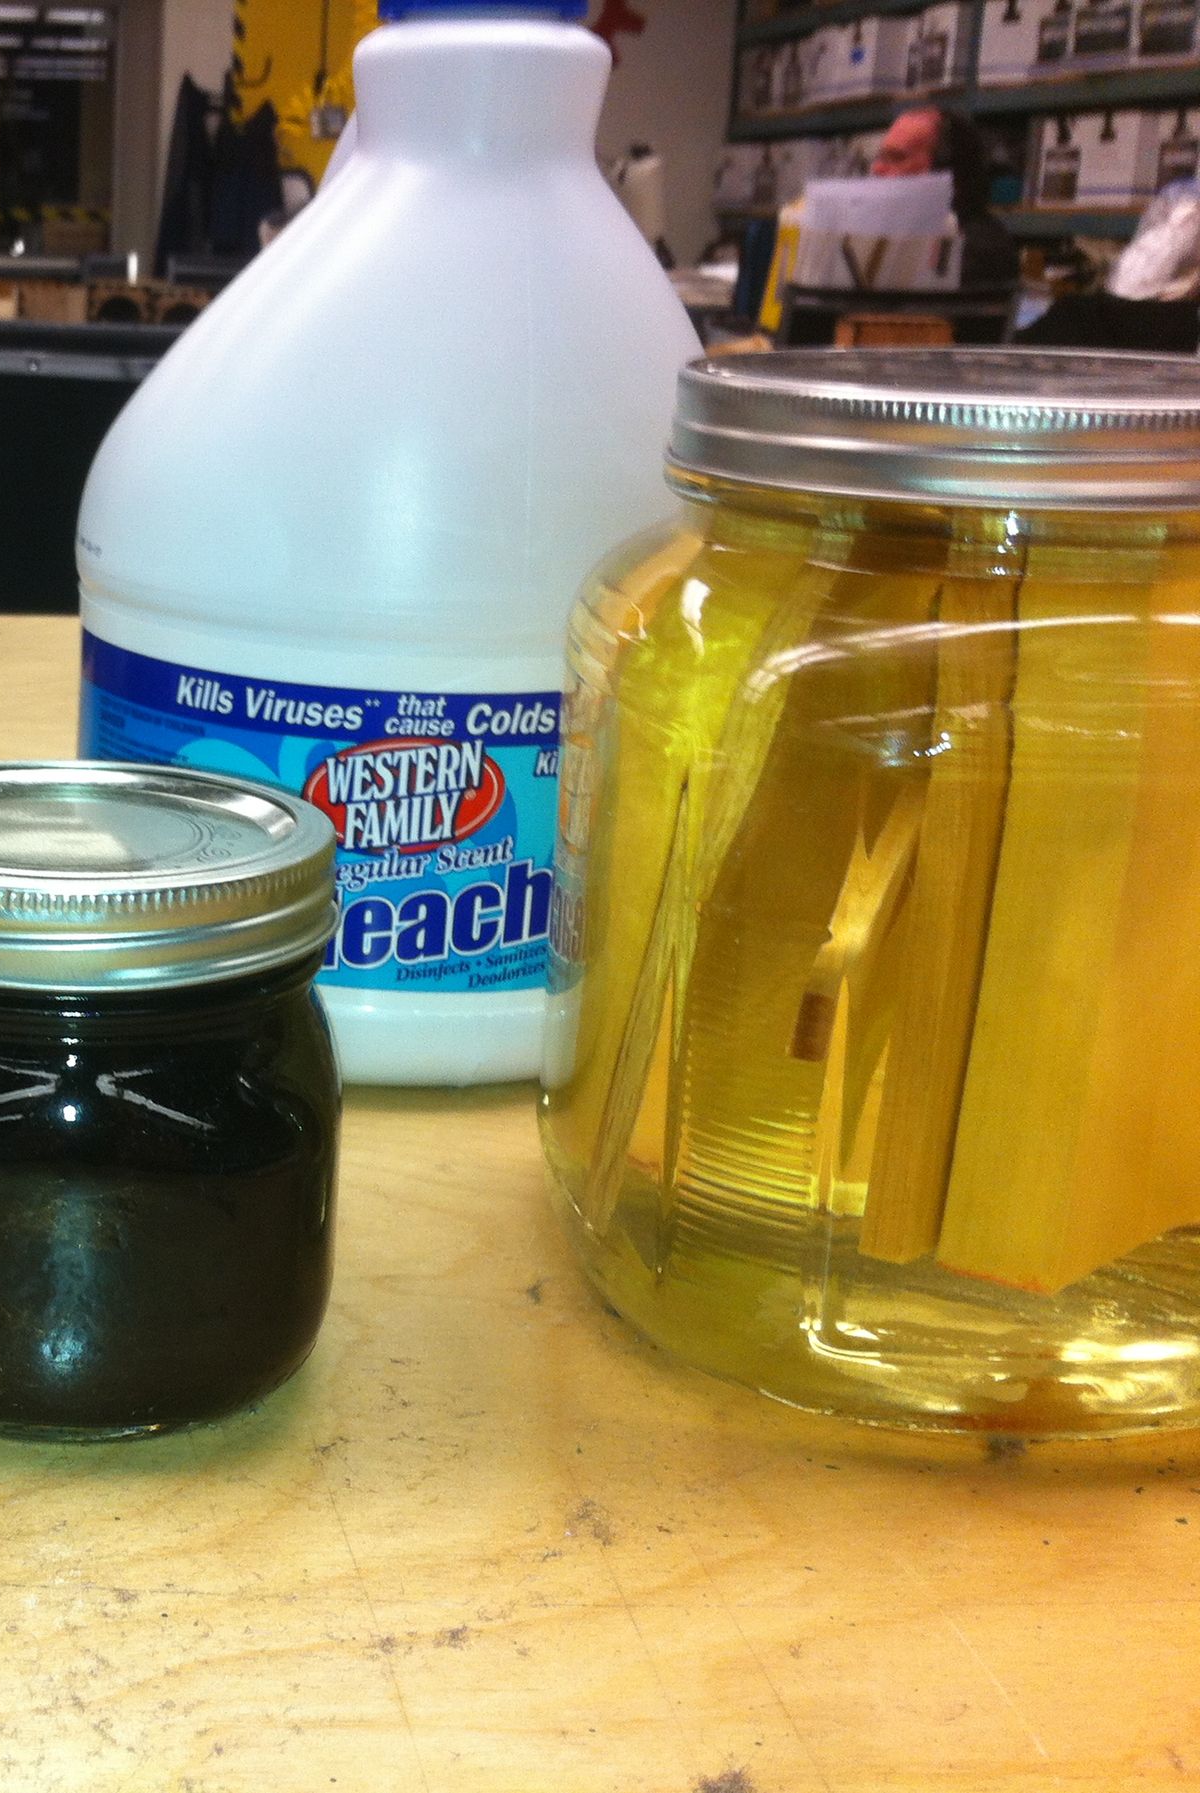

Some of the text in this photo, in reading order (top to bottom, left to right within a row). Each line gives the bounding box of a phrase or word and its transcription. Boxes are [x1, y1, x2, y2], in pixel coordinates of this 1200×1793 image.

[176, 674, 235, 715] Kills
[398, 694, 448, 717] that
[384, 717, 456, 736] cause
[466, 702, 556, 735] Colds
[326, 739, 483, 803] WESTERN
[535, 749, 560, 777] Ki
[344, 791, 461, 850] FAMILY
[335, 834, 515, 892] egular Scent
[320, 859, 554, 971] each
[396, 943, 547, 982] Disinfects Sanitizes
[468, 960, 546, 988] Deodorizes
